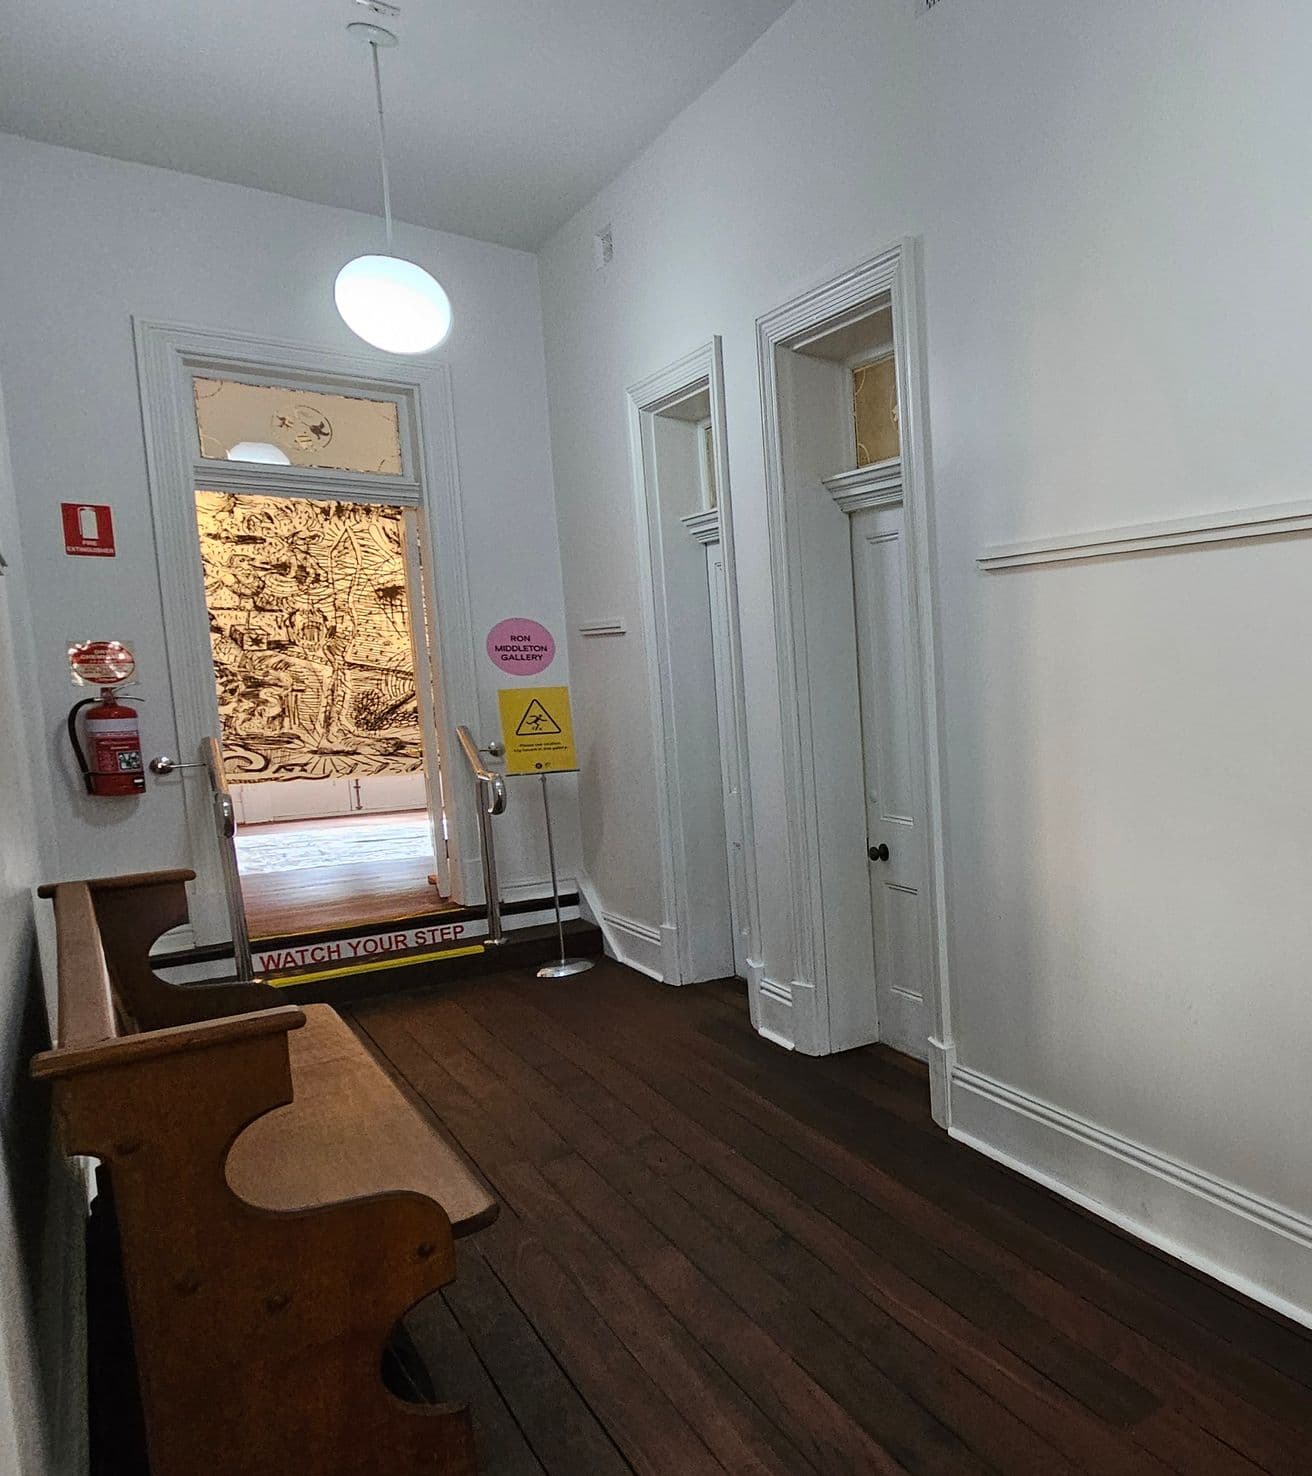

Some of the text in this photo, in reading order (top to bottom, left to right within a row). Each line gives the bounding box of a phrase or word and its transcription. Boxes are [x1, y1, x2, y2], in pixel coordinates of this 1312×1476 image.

[510, 634, 531, 642] RON
[494, 644, 548, 652] MIDDLETON
[259, 924, 466, 973] WATCH YOUR STEP
